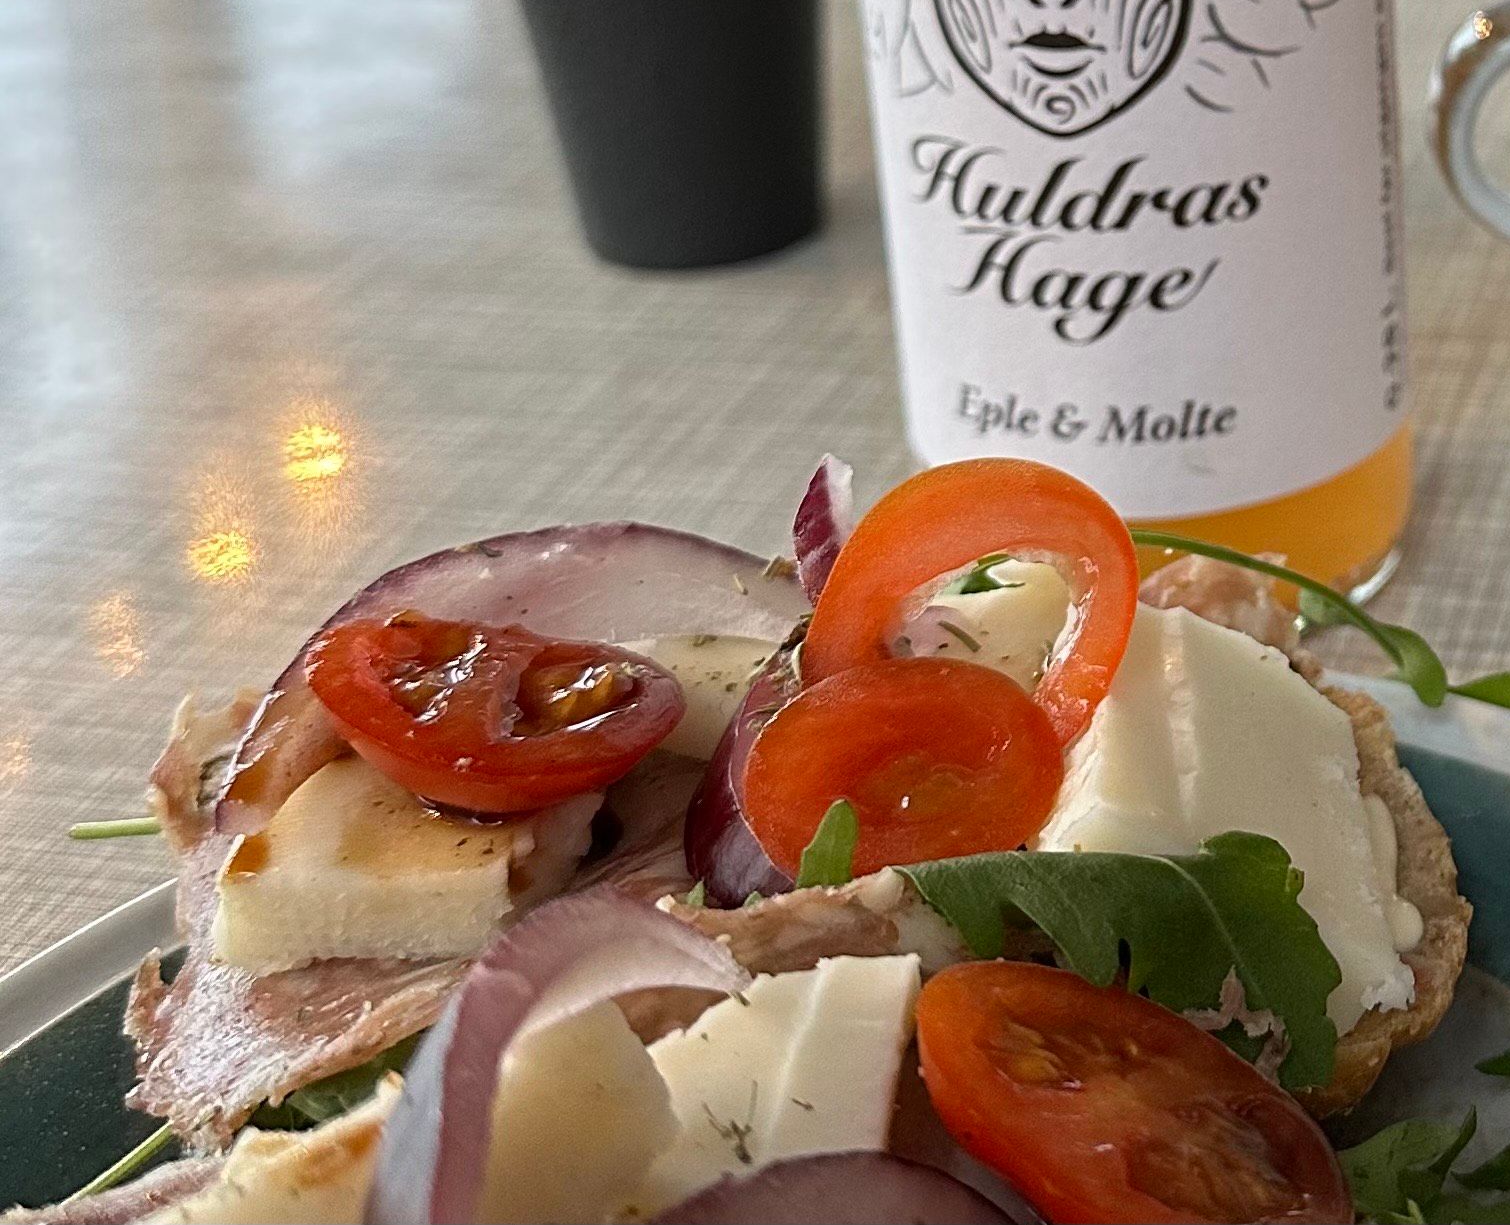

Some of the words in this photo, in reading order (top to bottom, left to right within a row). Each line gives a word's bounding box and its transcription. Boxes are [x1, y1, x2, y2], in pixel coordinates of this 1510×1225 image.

[910, 134, 1269, 232] Huldras
[952, 225, 1221, 347] Hage
[957, 381, 1040, 434] Eple
[1050, 401, 1087, 443] &
[1096, 398, 1238, 444] Molte
